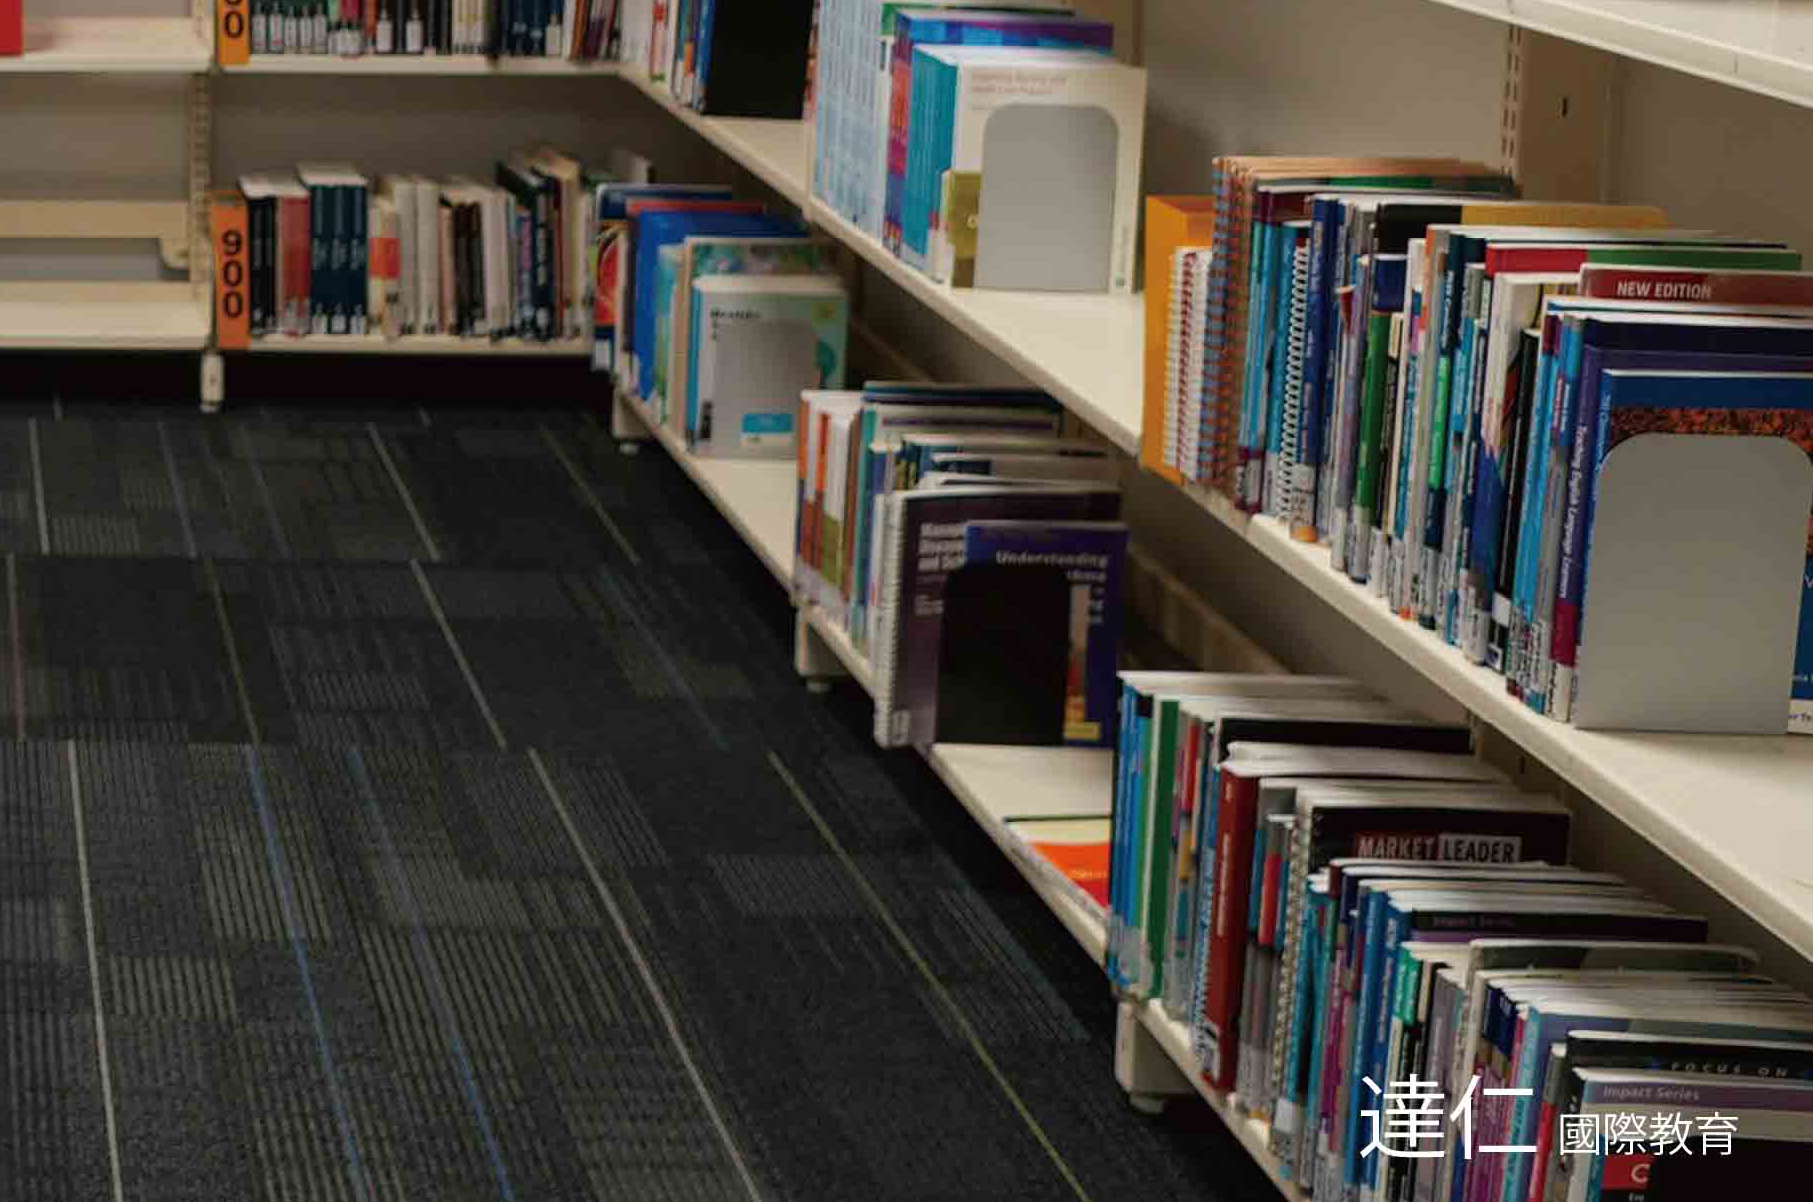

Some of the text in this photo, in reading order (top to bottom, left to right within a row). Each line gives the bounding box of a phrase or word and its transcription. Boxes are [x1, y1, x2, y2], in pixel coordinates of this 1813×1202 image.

[222, 230, 243, 319] 900
[1617, 282, 1711, 298] NEW EDITION
[1571, 425, 1588, 469] Teaching
[1567, 470, 1583, 505] English
[1561, 507, 1578, 556] Language
[995, 549, 1108, 567] Understanding
[1358, 833, 1516, 862] MARKET LEADER
[1670, 1061, 1741, 1074] FOCUS
[1603, 1084, 1700, 1101] Impact Series
